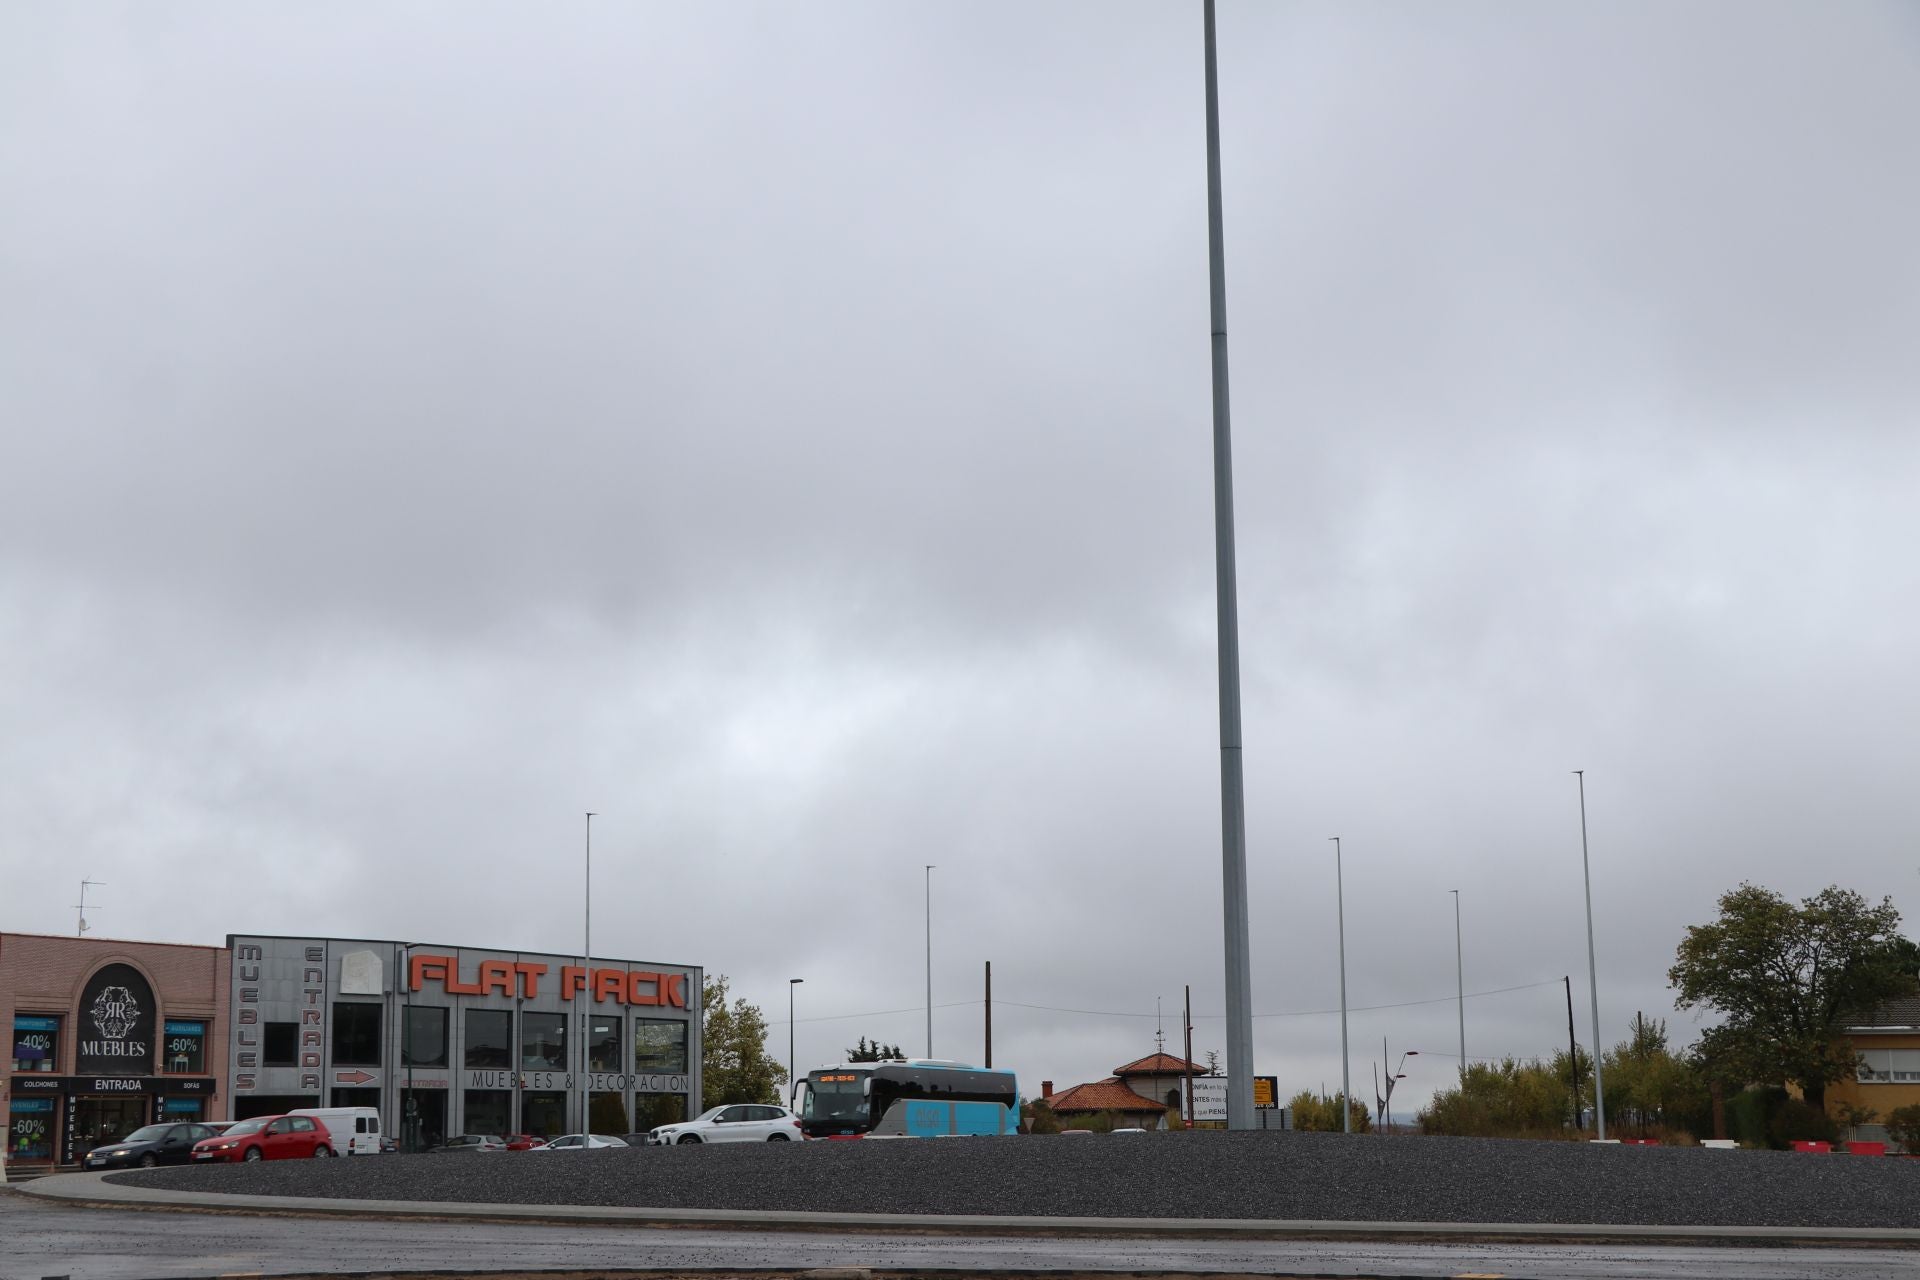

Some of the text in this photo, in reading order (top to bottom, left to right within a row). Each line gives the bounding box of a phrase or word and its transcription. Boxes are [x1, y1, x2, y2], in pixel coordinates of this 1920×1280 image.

[410, 954, 686, 1008] FLAT PACK
[236, 944, 262, 1090] MUEBLES
[301, 946, 324, 1089] ENTRADA
[82, 1040, 146, 1057] MUEBLES
[168, 1038, 197, 1052] -60%
[95, 1079, 142, 1091] ENTRADA
[472, 1071, 553, 1089] MUEBLES
[12, 1119, 45, 1134] -60%
[68, 1096, 76, 1160] MUEBLES
